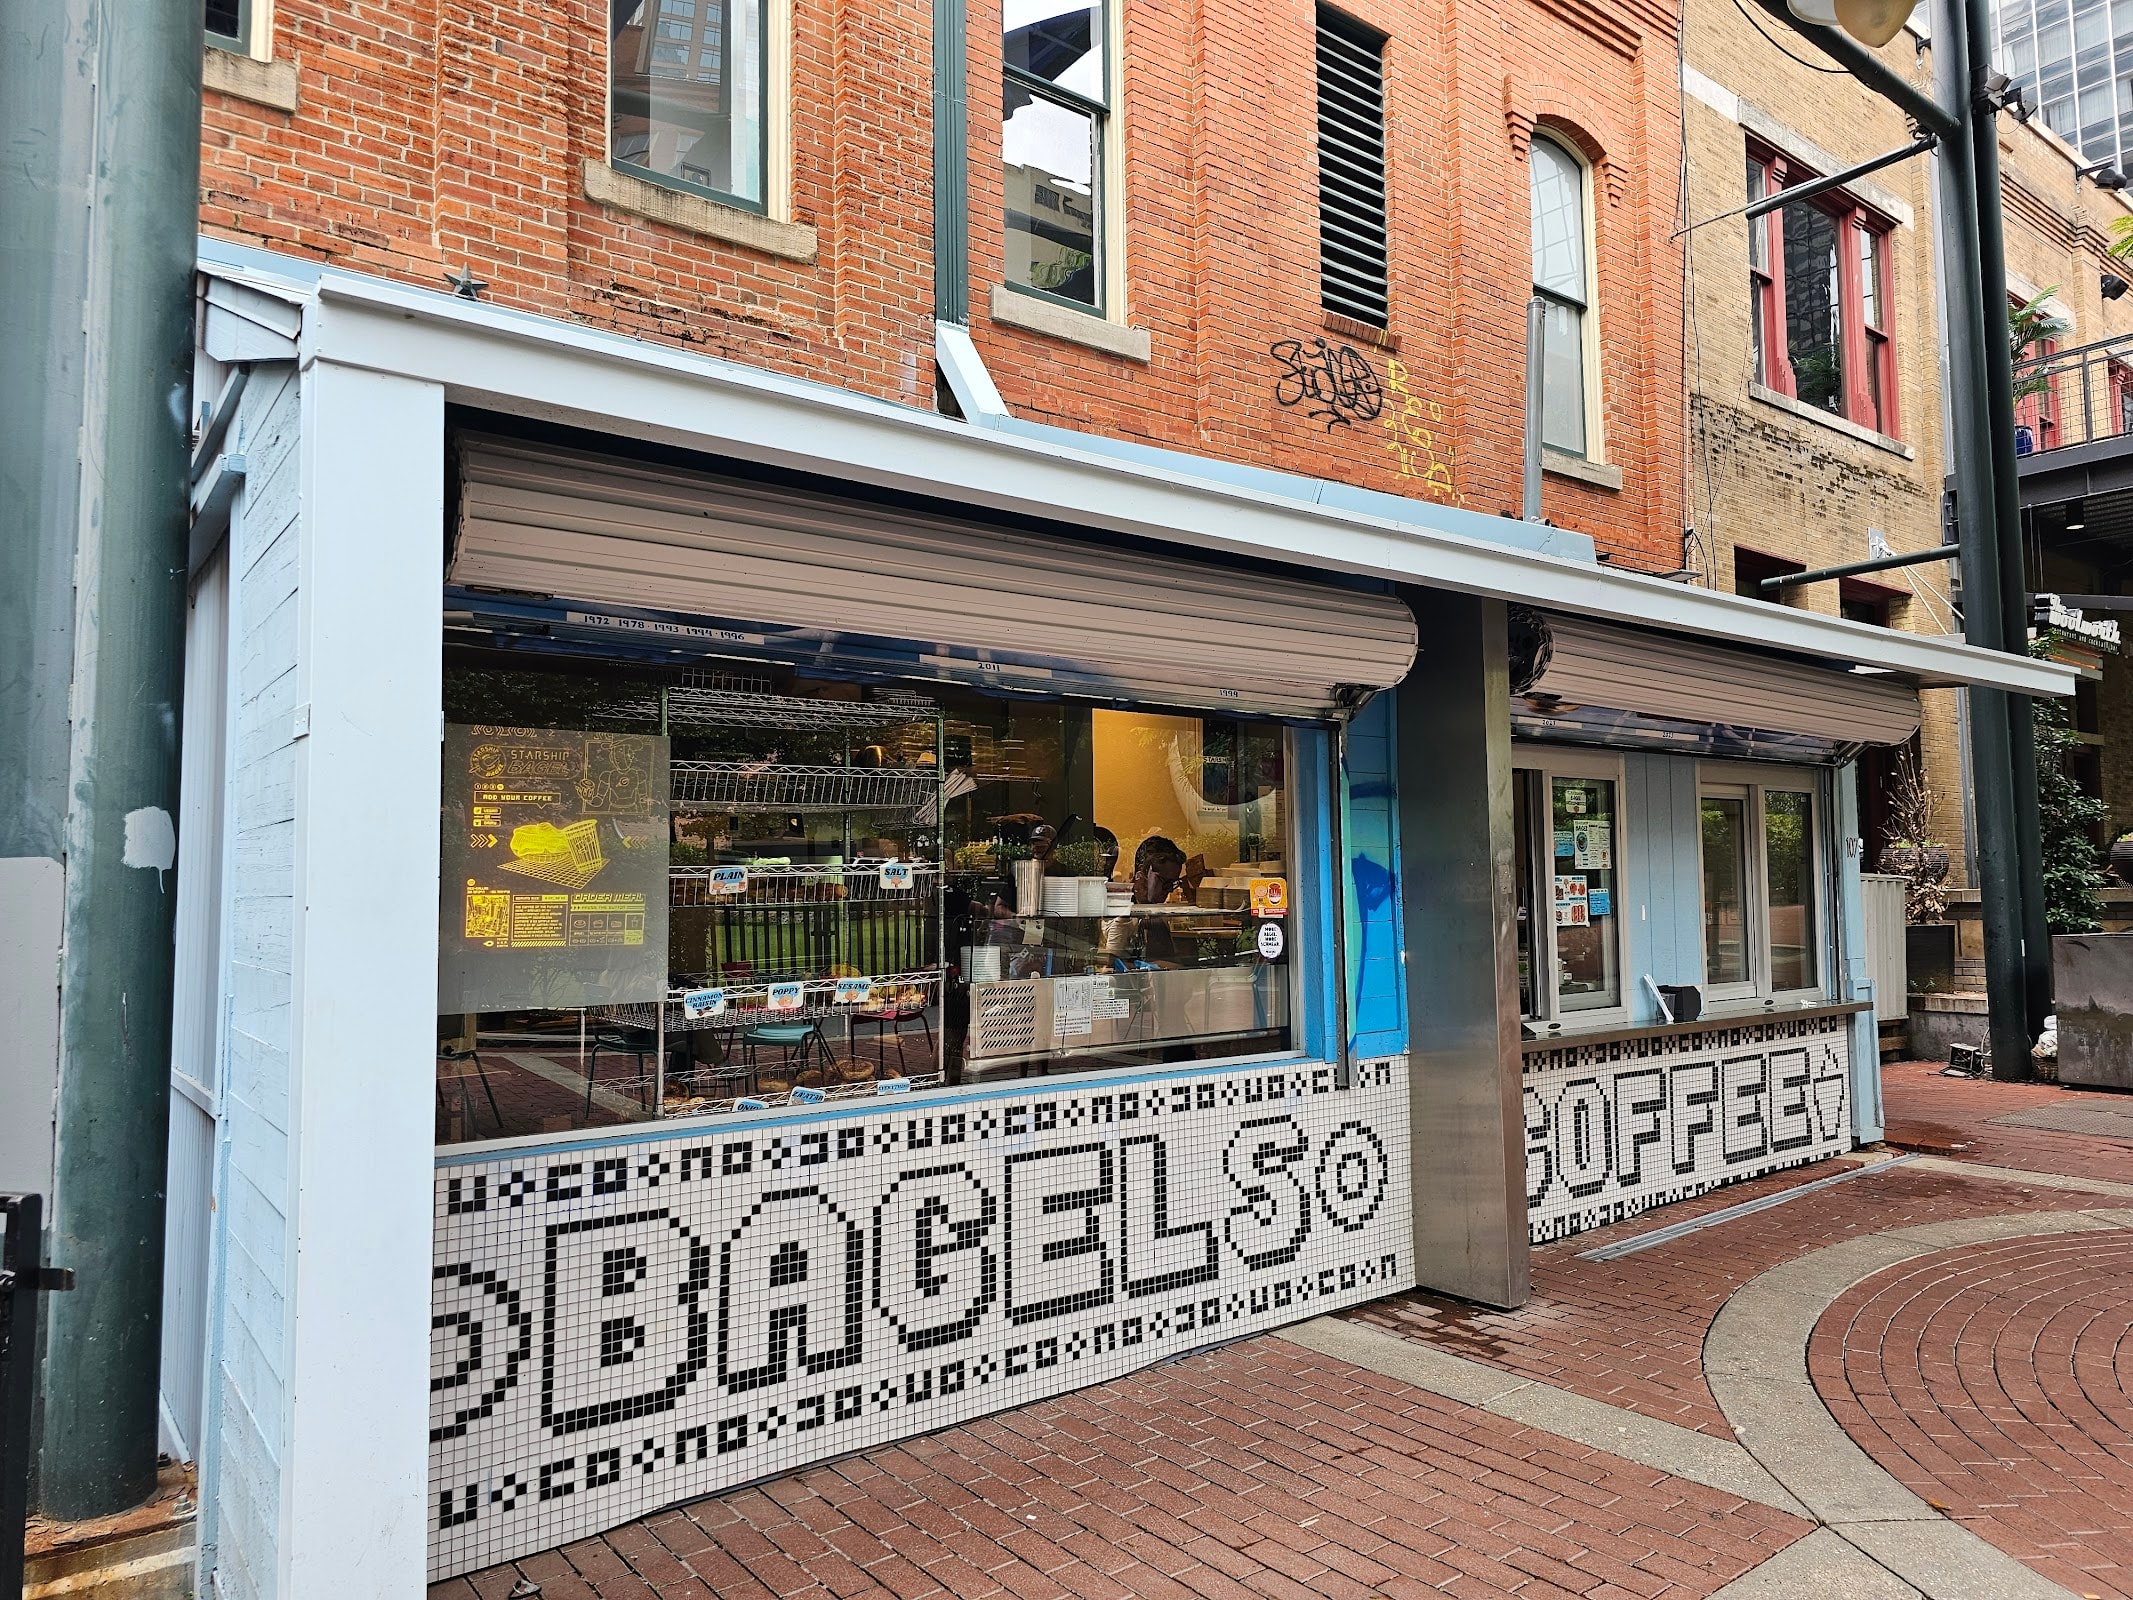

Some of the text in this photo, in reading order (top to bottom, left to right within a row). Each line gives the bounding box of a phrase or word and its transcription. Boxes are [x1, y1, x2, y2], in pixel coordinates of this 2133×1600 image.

[584, 615, 745, 641] 1972 1978 1993 1994 1996
[977, 662, 1000, 672] 2011
[1219, 689, 1239, 698] 1999
[511, 749, 570, 761] STARSHIP
[1845, 837, 1859, 858] 107
[713, 870, 745, 881] PLAIN
[884, 867, 908, 876] SALT
[772, 986, 801, 996] POPPY
[685, 992, 723, 1004] CINNAMON
[692, 999, 717, 1009] RAISIN
[792, 1090, 824, 1101] ZA'ATAR
[737, 1102, 763, 1111] ONI
[541, 1114, 1310, 1436] BAGELS
